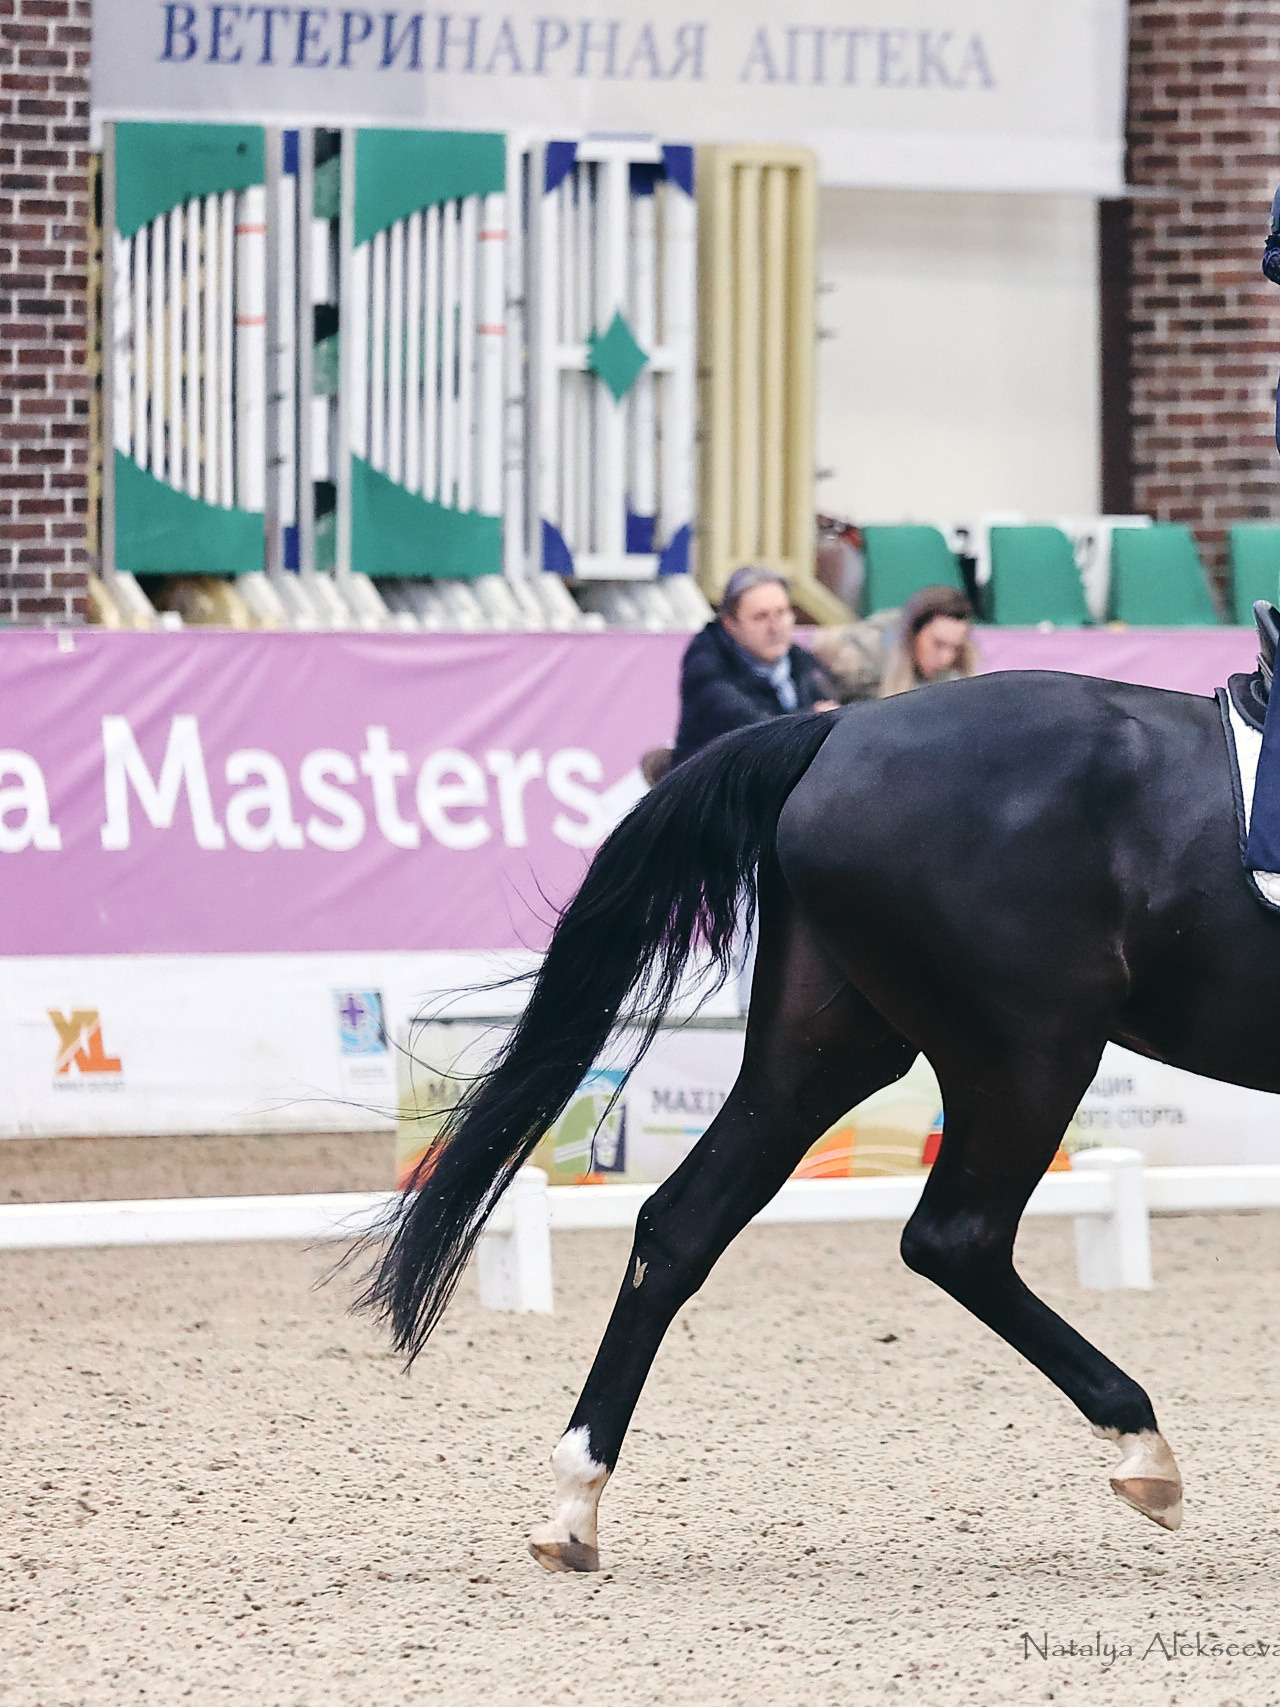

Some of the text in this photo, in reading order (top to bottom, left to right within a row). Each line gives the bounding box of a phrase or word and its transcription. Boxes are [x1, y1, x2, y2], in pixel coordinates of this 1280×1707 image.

[157, 2, 996, 91] ВЕТЕРИНАРНАЯ АПТЕКА
[101, 713, 605, 852] Masters
